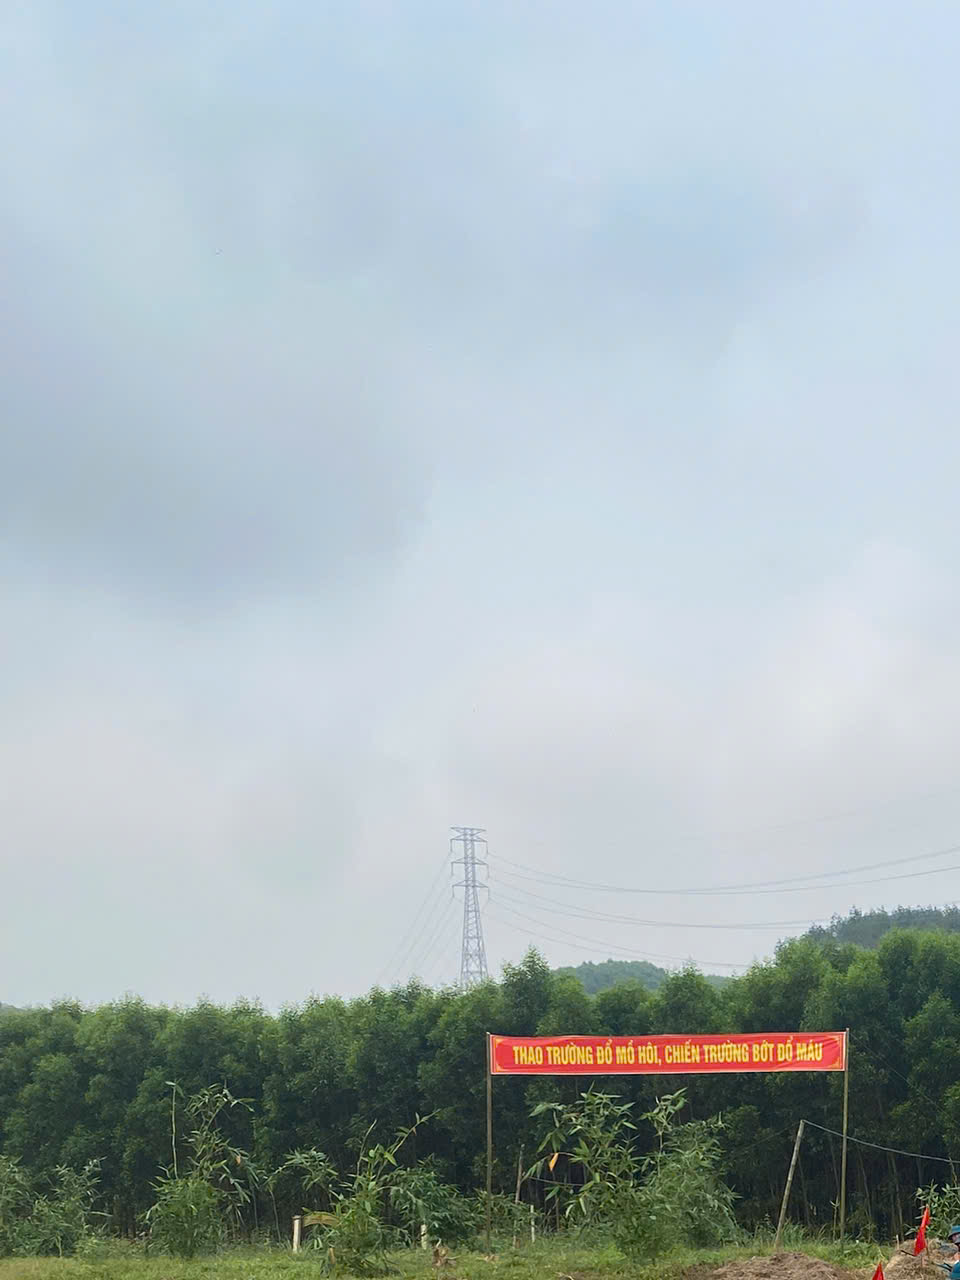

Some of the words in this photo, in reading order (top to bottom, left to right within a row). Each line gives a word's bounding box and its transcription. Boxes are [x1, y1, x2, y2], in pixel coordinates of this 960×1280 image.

[512, 1046, 543, 1065] THAO
[546, 1042, 594, 1065] TRƯỜNG
[596, 1038, 613, 1065] ĐỔ
[638, 1042, 662, 1066] HÔI,
[665, 1039, 700, 1064] CHIẾN
[703, 1040, 750, 1063] TRƯỜNG
[752, 1039, 775, 1063] BỚT
[796, 1039, 824, 1062] MÁU
